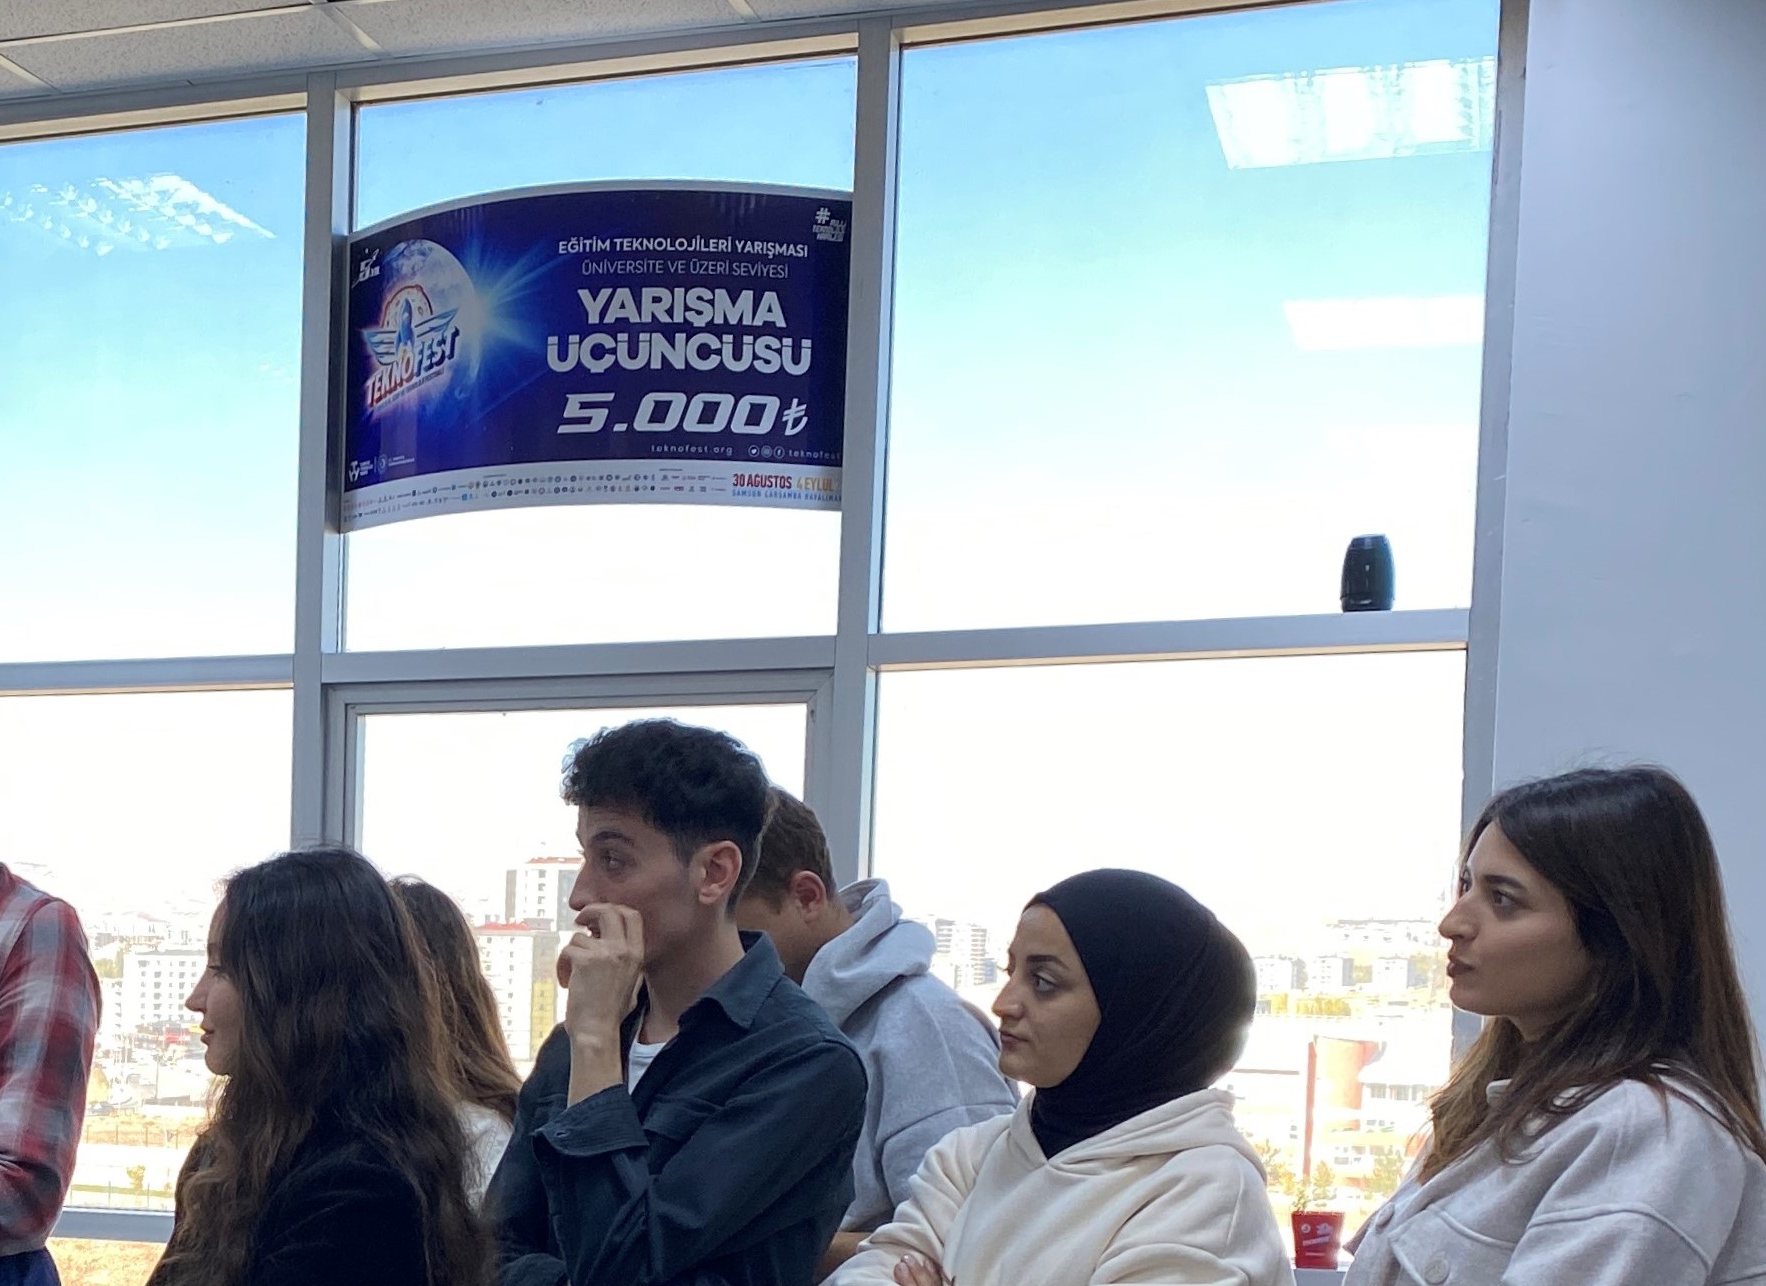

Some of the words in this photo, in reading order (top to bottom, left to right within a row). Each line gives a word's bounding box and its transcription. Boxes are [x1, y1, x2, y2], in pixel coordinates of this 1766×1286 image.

[559, 236, 610, 254] EĞİTİM
[614, 235, 732, 252] TEKNOLOJİLERİ
[735, 240, 808, 259] YARIŞMASI
[668, 260, 686, 273] VE
[577, 287, 786, 327] YARIŞMA
[365, 326, 460, 408] TEKNOFEST
